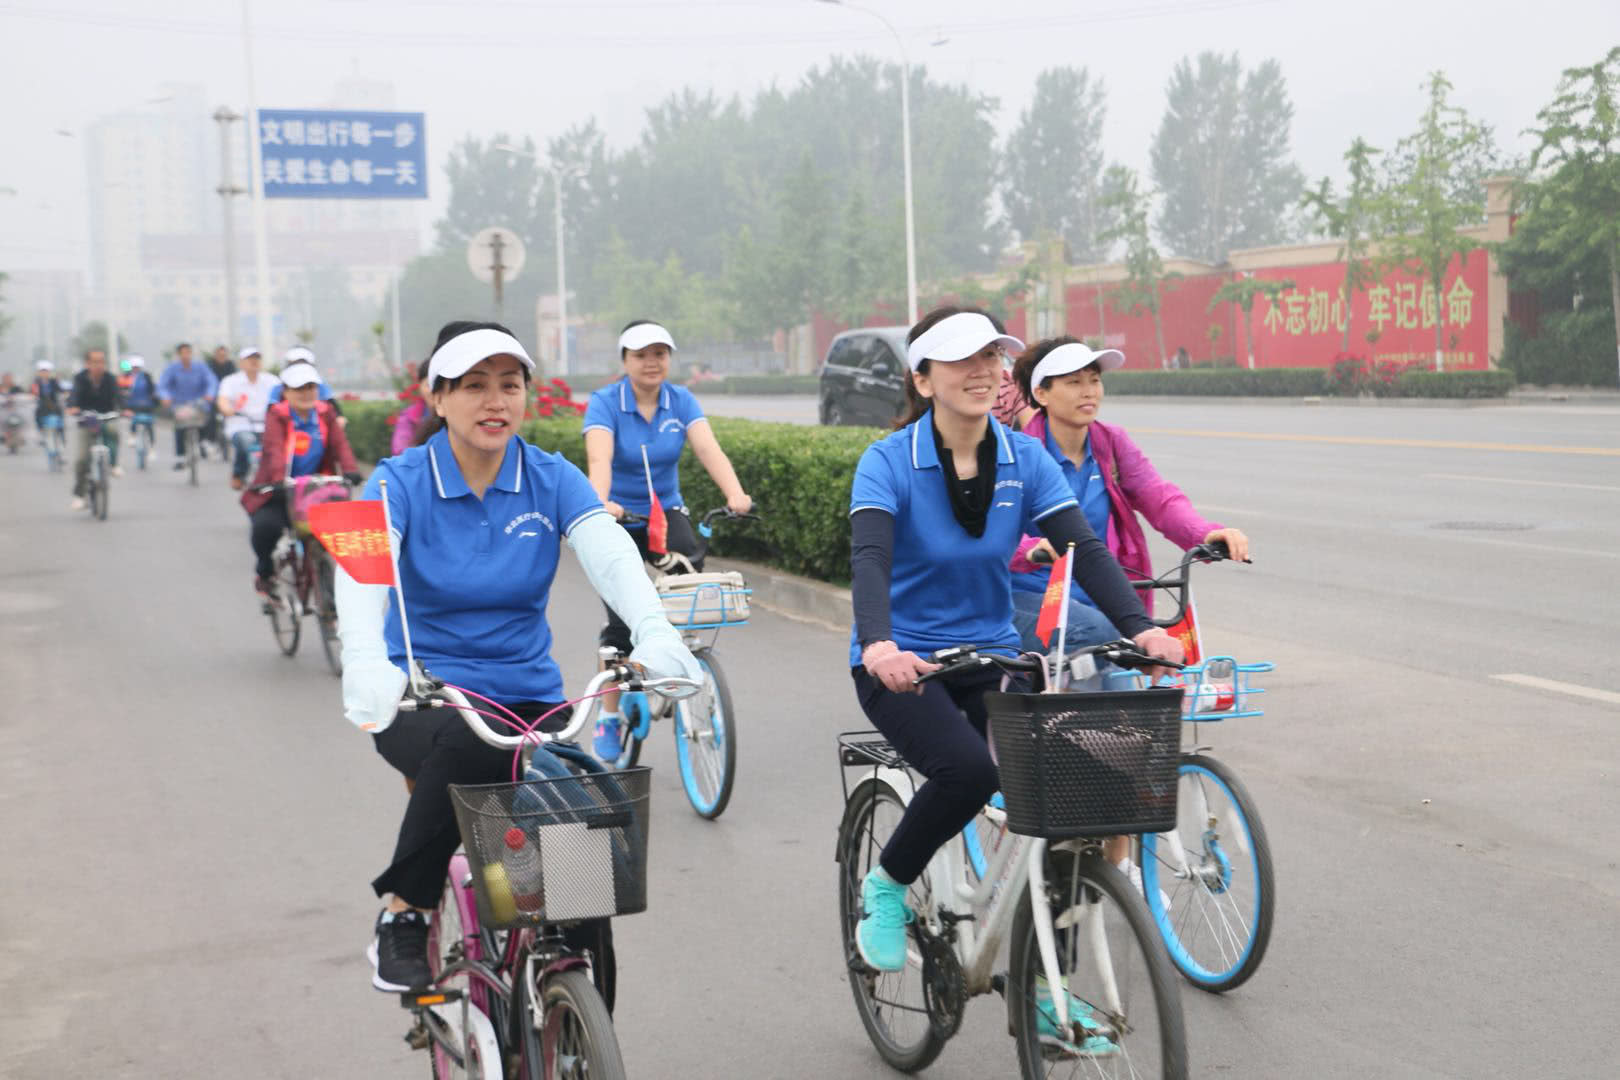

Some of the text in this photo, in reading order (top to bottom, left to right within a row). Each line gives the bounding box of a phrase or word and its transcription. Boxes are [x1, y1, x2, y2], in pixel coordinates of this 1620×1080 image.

[261, 119, 416, 148] 文明出行每一步
